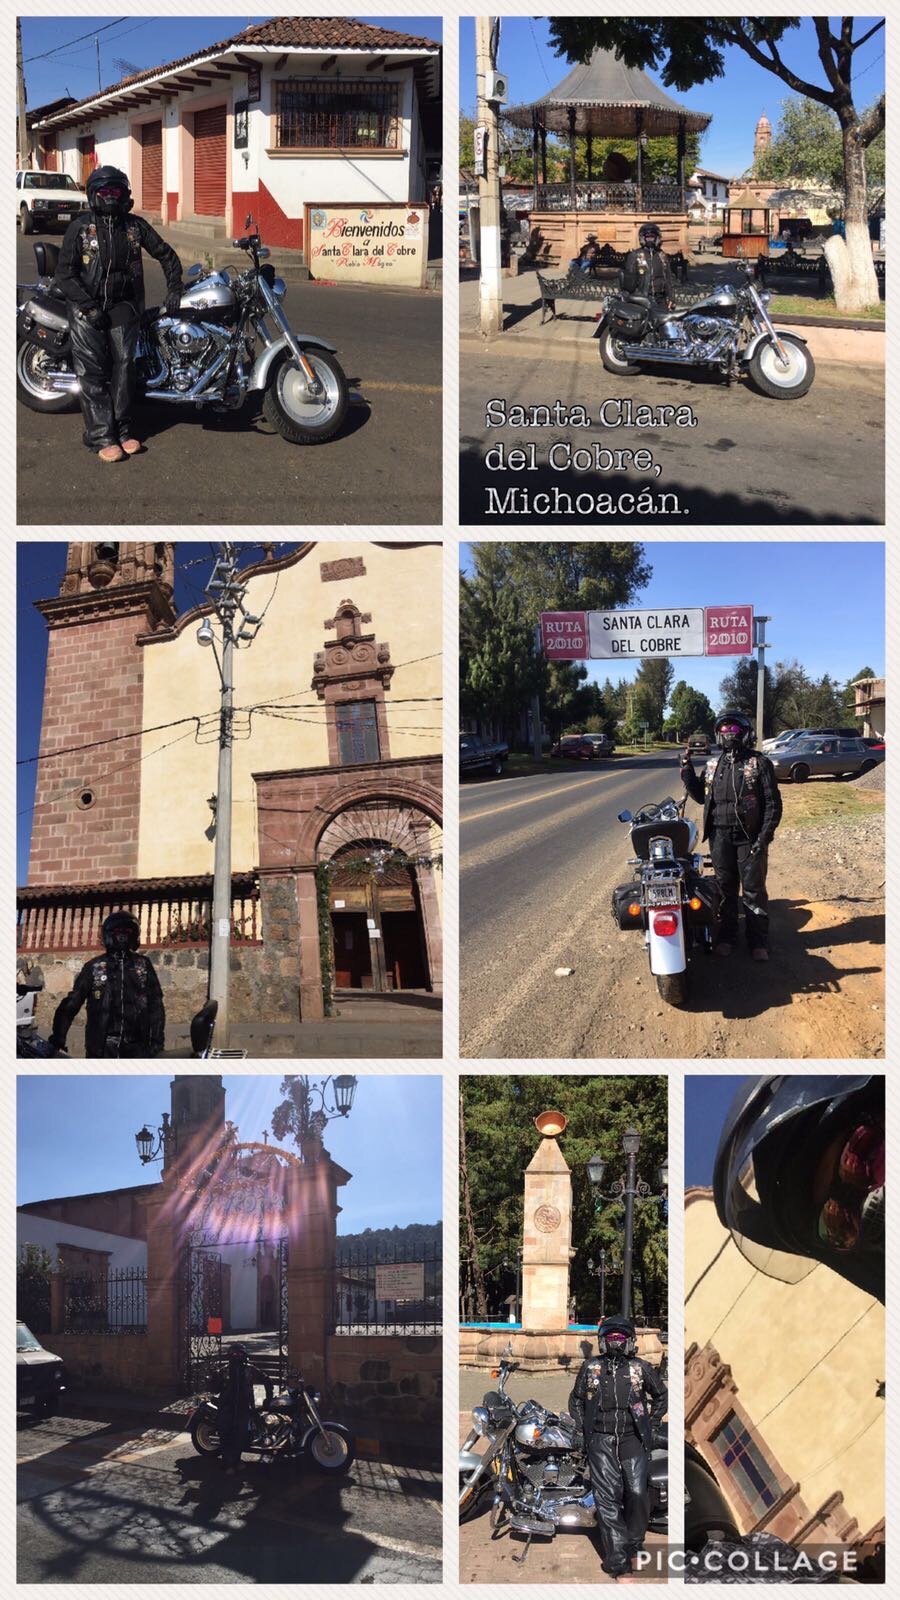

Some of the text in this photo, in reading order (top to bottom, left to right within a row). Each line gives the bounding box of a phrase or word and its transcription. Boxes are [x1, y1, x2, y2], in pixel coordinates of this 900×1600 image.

[322, 217, 406, 238] Bienvenidos
[311, 242, 417, 257] Santa Clara del Cobre
[545, 621, 583, 633] RUTA
[602, 614, 691, 631] SANTA CLARA
[709, 615, 749, 628] RUTA
[546, 637, 584, 650] 2010
[611, 637, 682, 653] DEL COBRE
[709, 632, 749, 646] 2010
